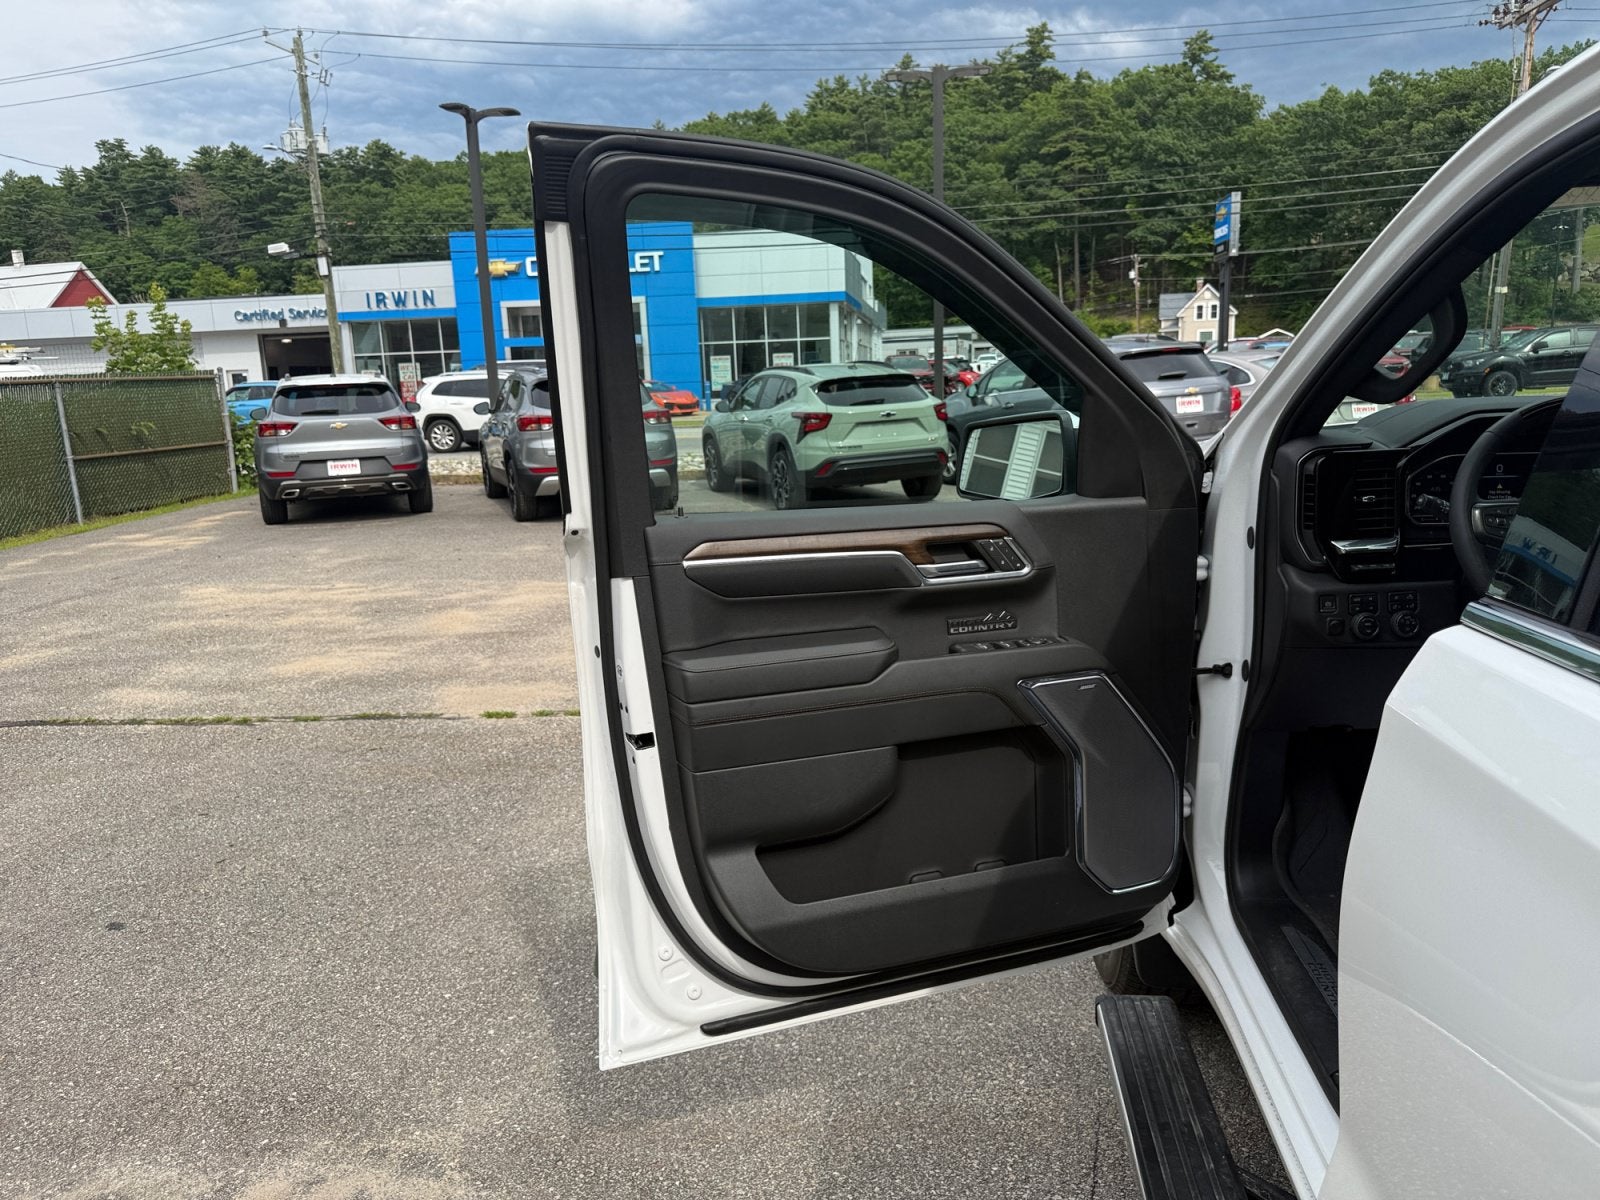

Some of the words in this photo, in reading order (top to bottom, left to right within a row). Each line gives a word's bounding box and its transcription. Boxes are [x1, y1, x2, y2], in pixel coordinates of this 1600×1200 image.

[366, 289, 435, 309] IRWIN
[234, 307, 284, 321] Certified
[950, 621, 1015, 634] COUNTRY
